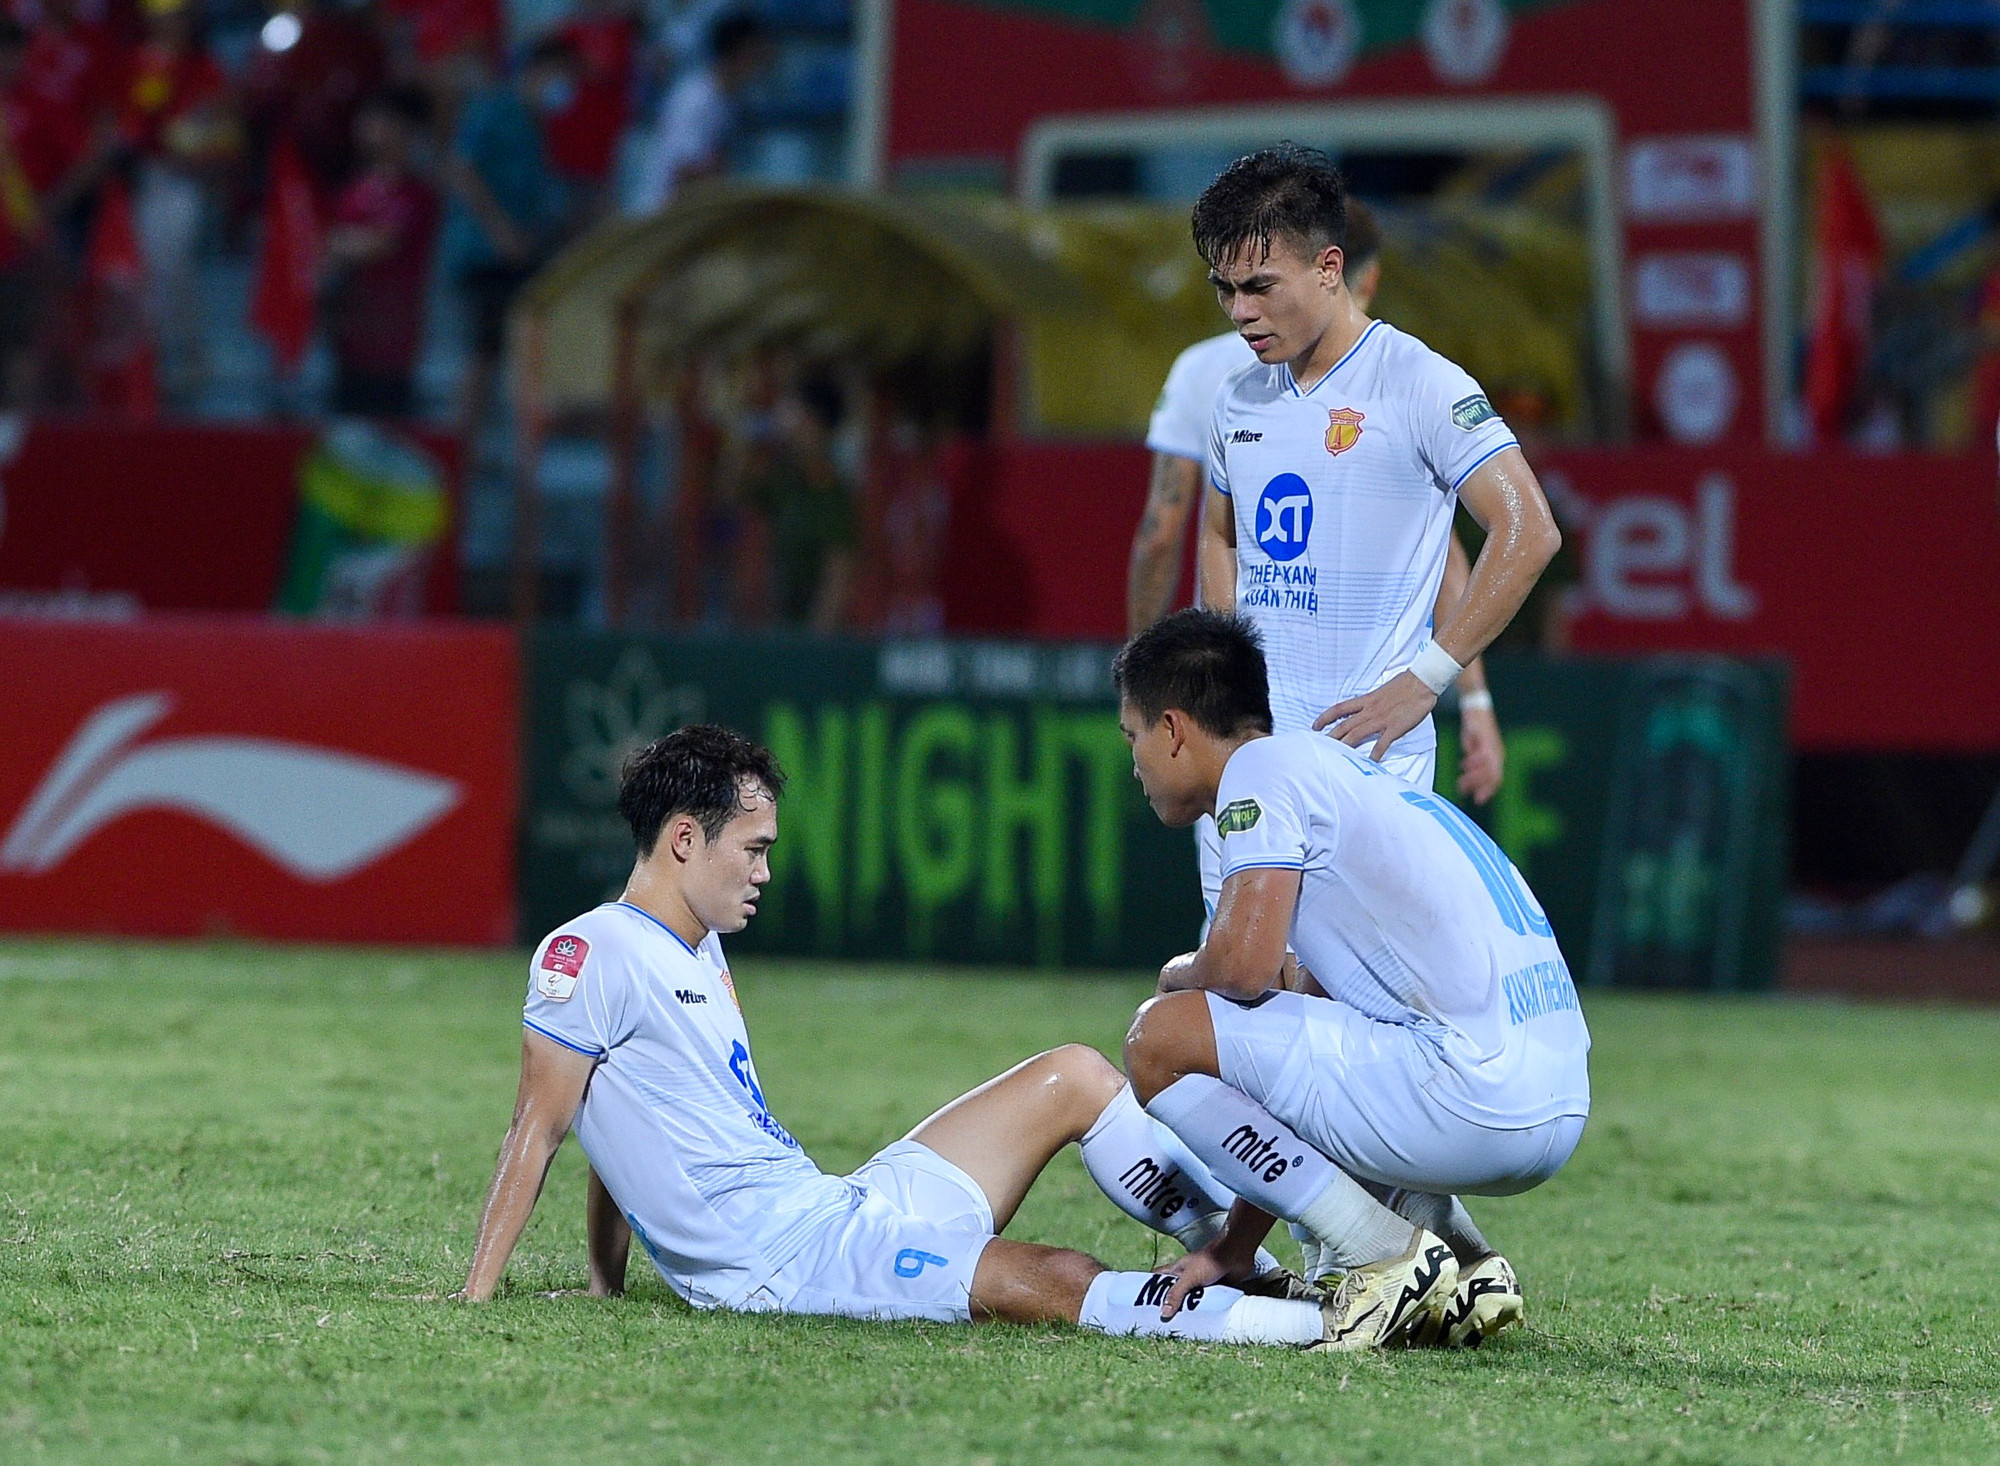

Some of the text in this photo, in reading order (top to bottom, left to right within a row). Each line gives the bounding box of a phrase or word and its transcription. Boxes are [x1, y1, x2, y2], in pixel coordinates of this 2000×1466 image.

[1230, 429, 1263, 444] Mitre
[1231, 808, 1257, 825] WOLF
[675, 989, 708, 1004] Mitre
